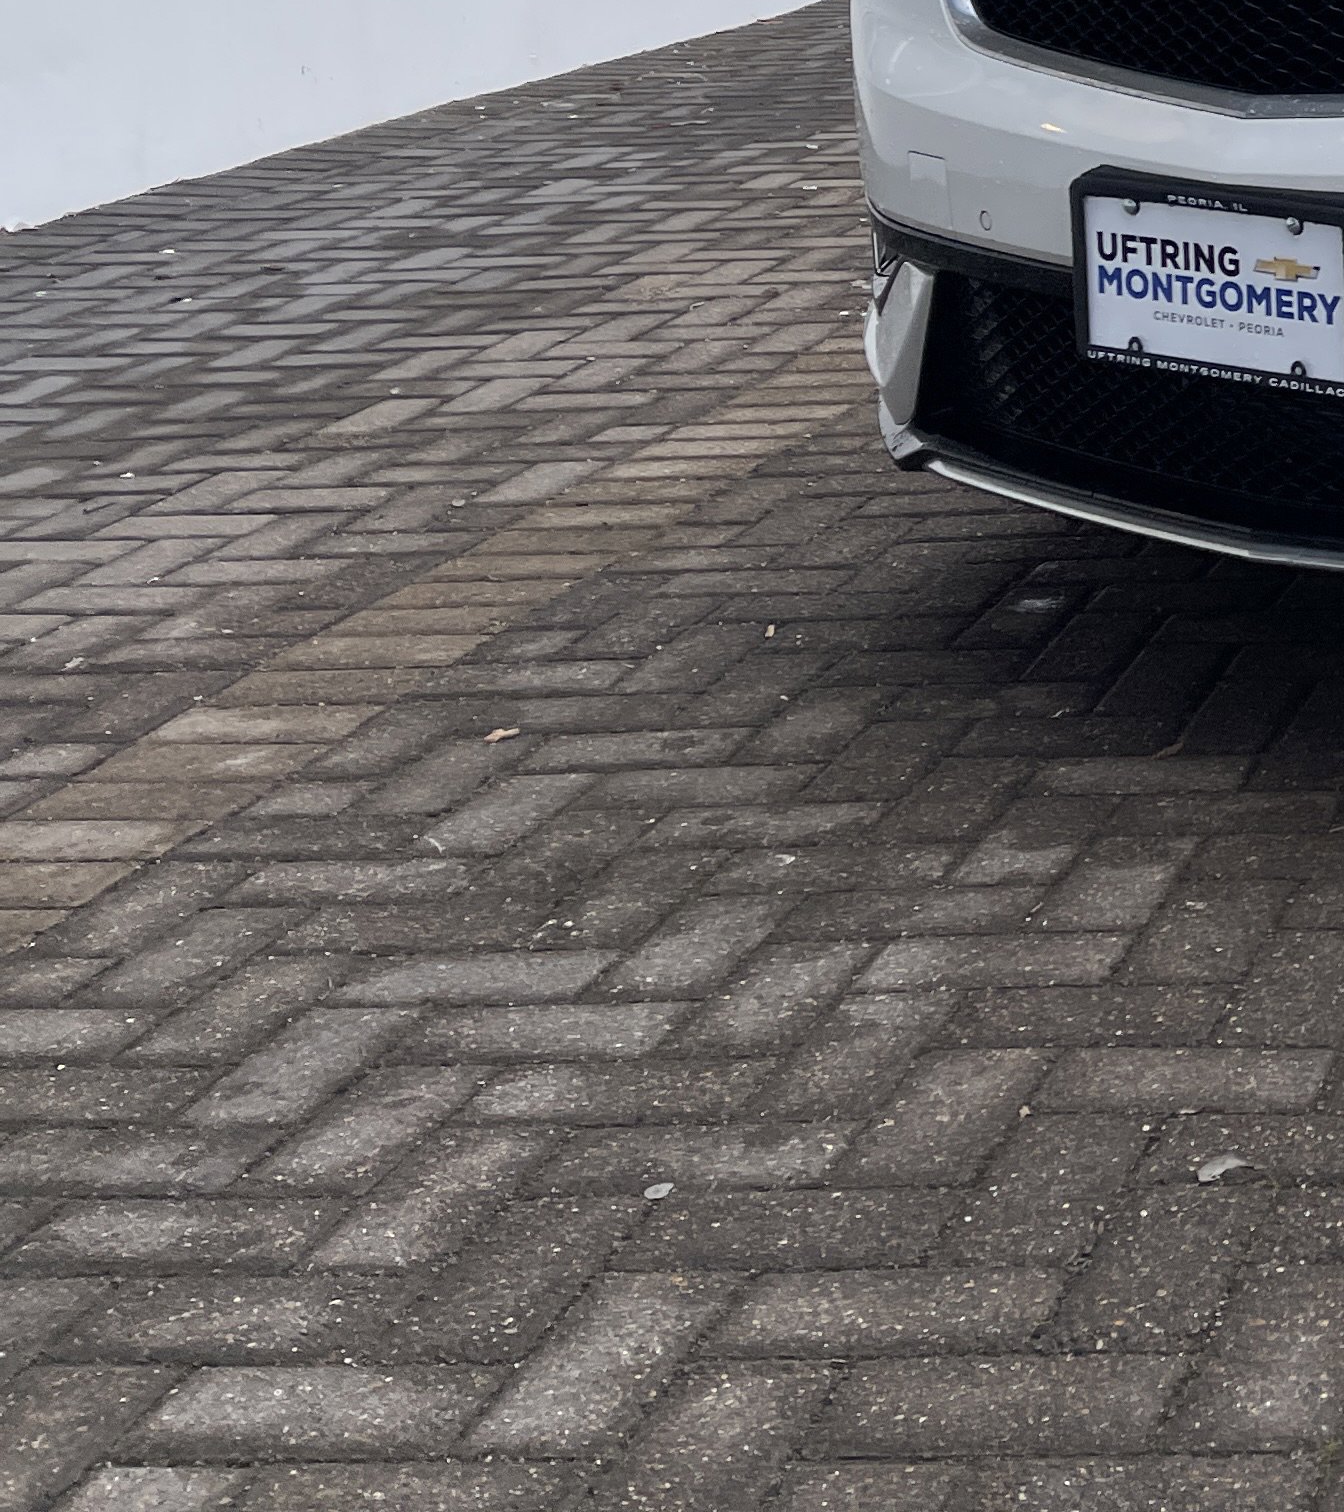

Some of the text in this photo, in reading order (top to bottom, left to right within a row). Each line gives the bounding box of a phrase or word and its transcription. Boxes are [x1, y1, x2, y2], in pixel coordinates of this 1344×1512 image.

[1096, 231, 1240, 277] UFTRING
[1098, 264, 1341, 325] MONTGOMERY
[1153, 310, 1285, 338] CHEVROLET PEORIA
[1087, 349, 1151, 367] UFTRING
[1156, 359, 1263, 384] MONTGOMERY
